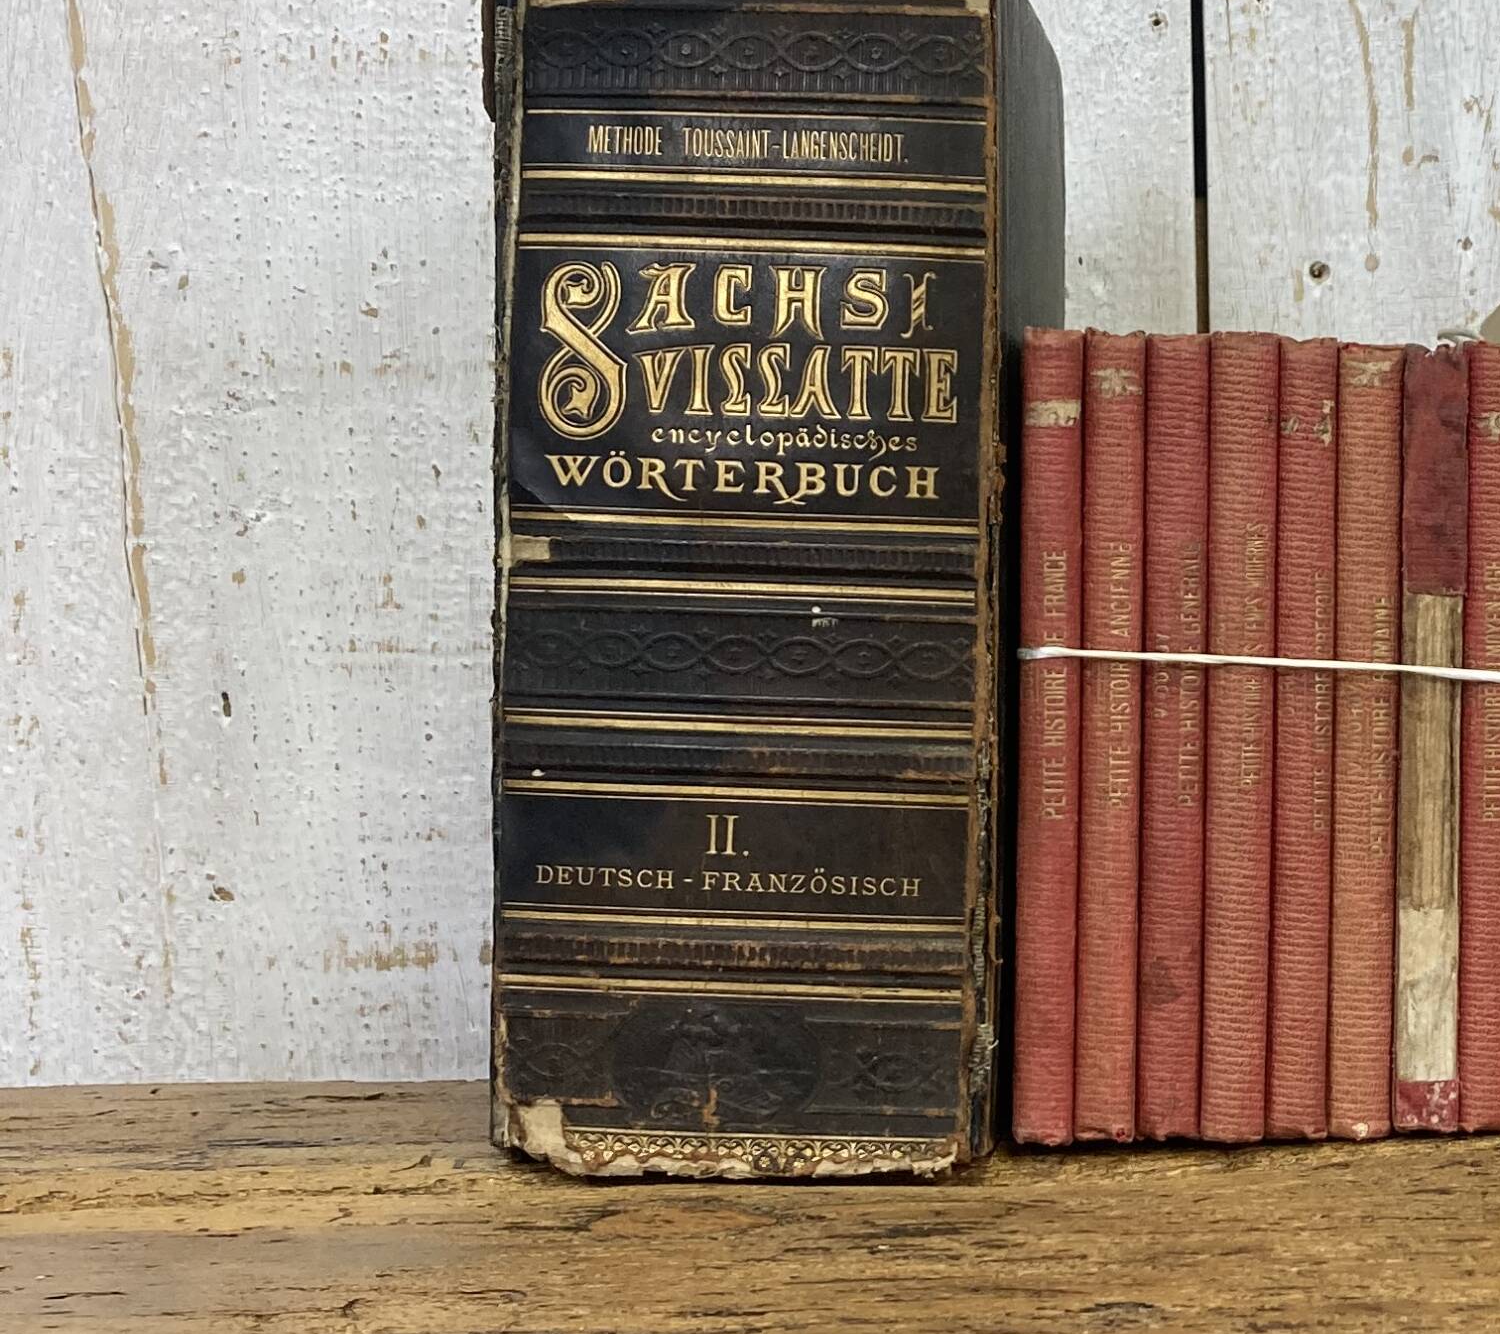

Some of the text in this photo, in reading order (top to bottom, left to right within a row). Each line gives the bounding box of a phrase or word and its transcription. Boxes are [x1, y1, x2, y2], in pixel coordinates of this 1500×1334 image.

[587, 125, 664, 157] METHODE
[651, 425, 918, 459] encyclopädisches
[544, 451, 940, 505] WÖRTERBUCH
[1042, 549, 1068, 618] FRANCE
[1371, 596, 1393, 683] RMAINE
[1041, 666, 1068, 748] HISTOIRE
[1108, 657, 1132, 733] HISTOIR
[1040, 756, 1068, 820] PETITE
[1107, 745, 1132, 810] PETITE
[1178, 741, 1200, 807] PETITE
[704, 813, 751, 858] II.
